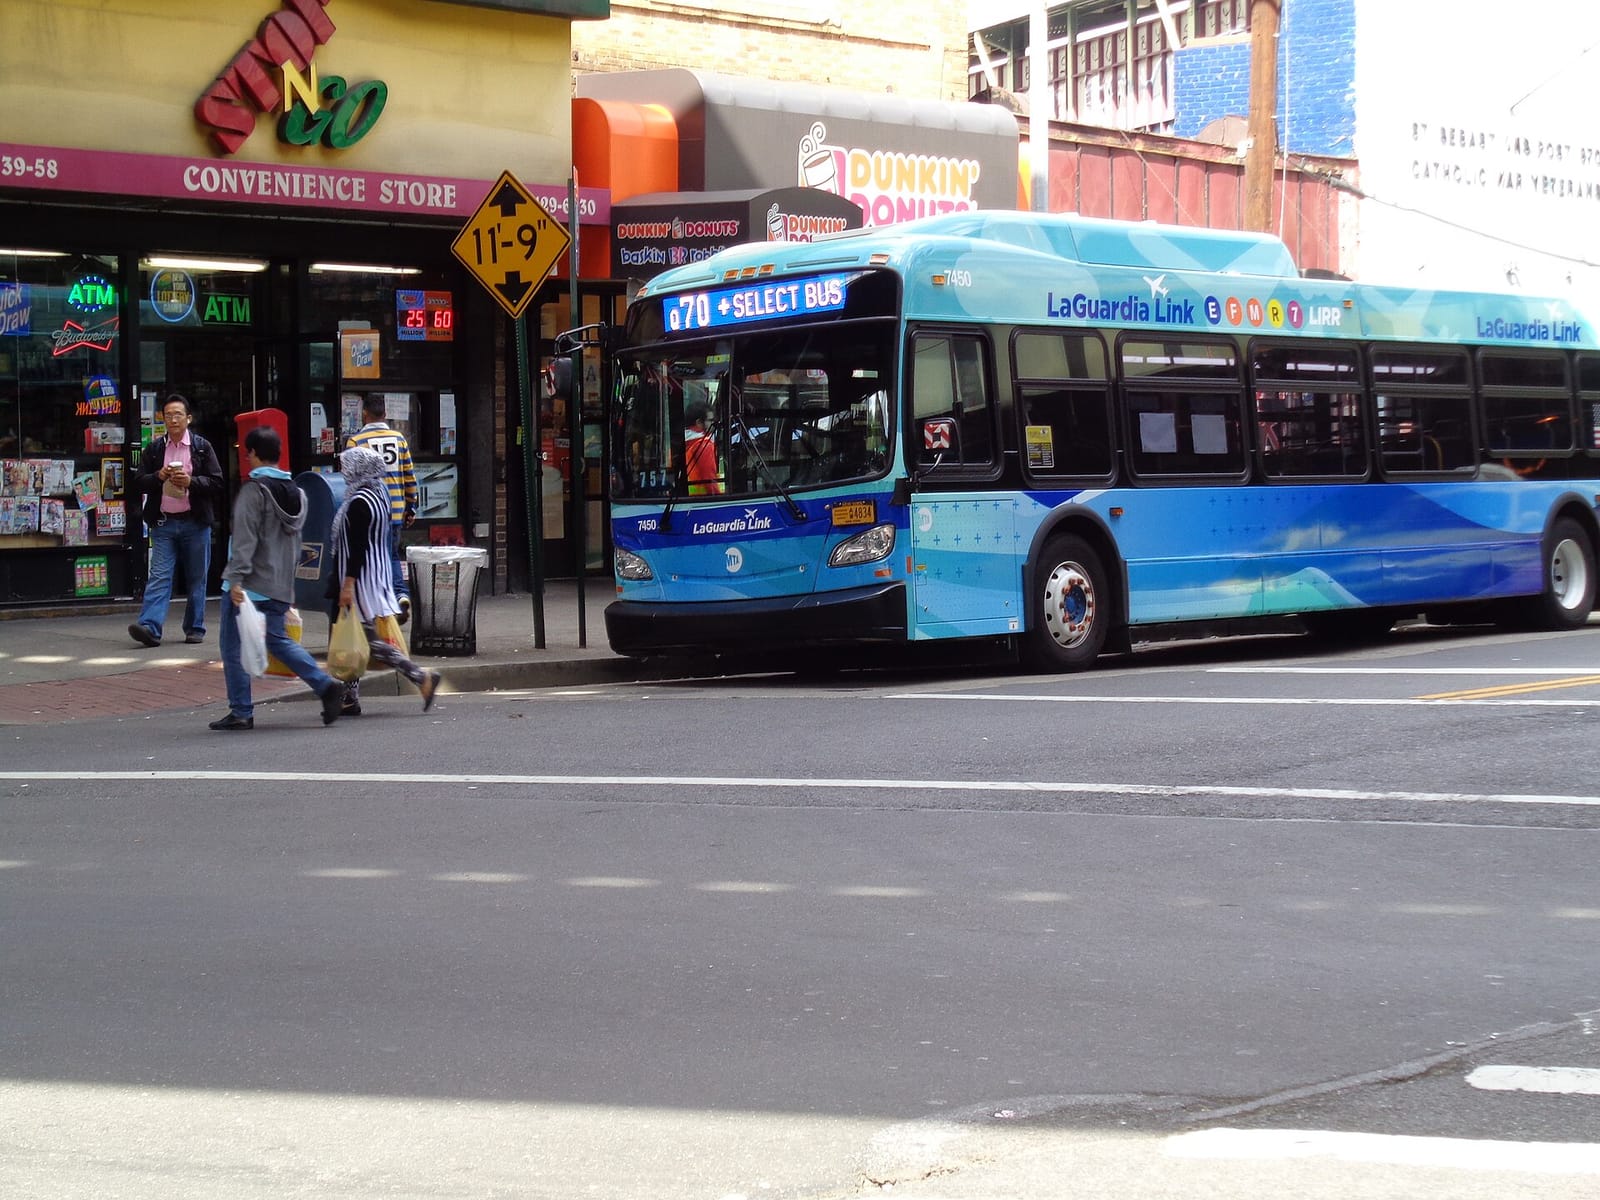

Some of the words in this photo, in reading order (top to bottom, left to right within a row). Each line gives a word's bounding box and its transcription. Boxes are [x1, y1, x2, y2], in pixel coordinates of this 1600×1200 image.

[280, 59, 321, 115] N
[278, 74, 389, 149] GO
[1, 156, 58, 179] 39-58
[849, 152, 978, 198] DUNKIN'
[183, 165, 366, 202] CONVENIENCE
[379, 179, 457, 209] STORE
[618, 223, 671, 239] DUNKIN'
[685, 220, 738, 238] DONUTS
[788, 214, 847, 243] DUNKIN'
[620, 246, 666, 266] baskin
[944, 269, 972, 288] 7450
[67, 283, 114, 305] ATM
[670, 293, 710, 331] Q70
[804, 279, 842, 309] BUS
[204, 295, 251, 322] ATM
[406, 310, 424, 327] 25
[434, 310, 451, 328] 60
[1047, 292, 1149, 323] LaGuardia
[1155, 297, 1195, 325] Link
[1309, 306, 1341, 326] LIRR
[1476, 316, 1549, 341] LaGuardia
[1552, 321, 1581, 342] Link
[637, 519, 657, 531] 7450
[692, 518, 746, 535] LaGuardia
[748, 516, 771, 530] Link
